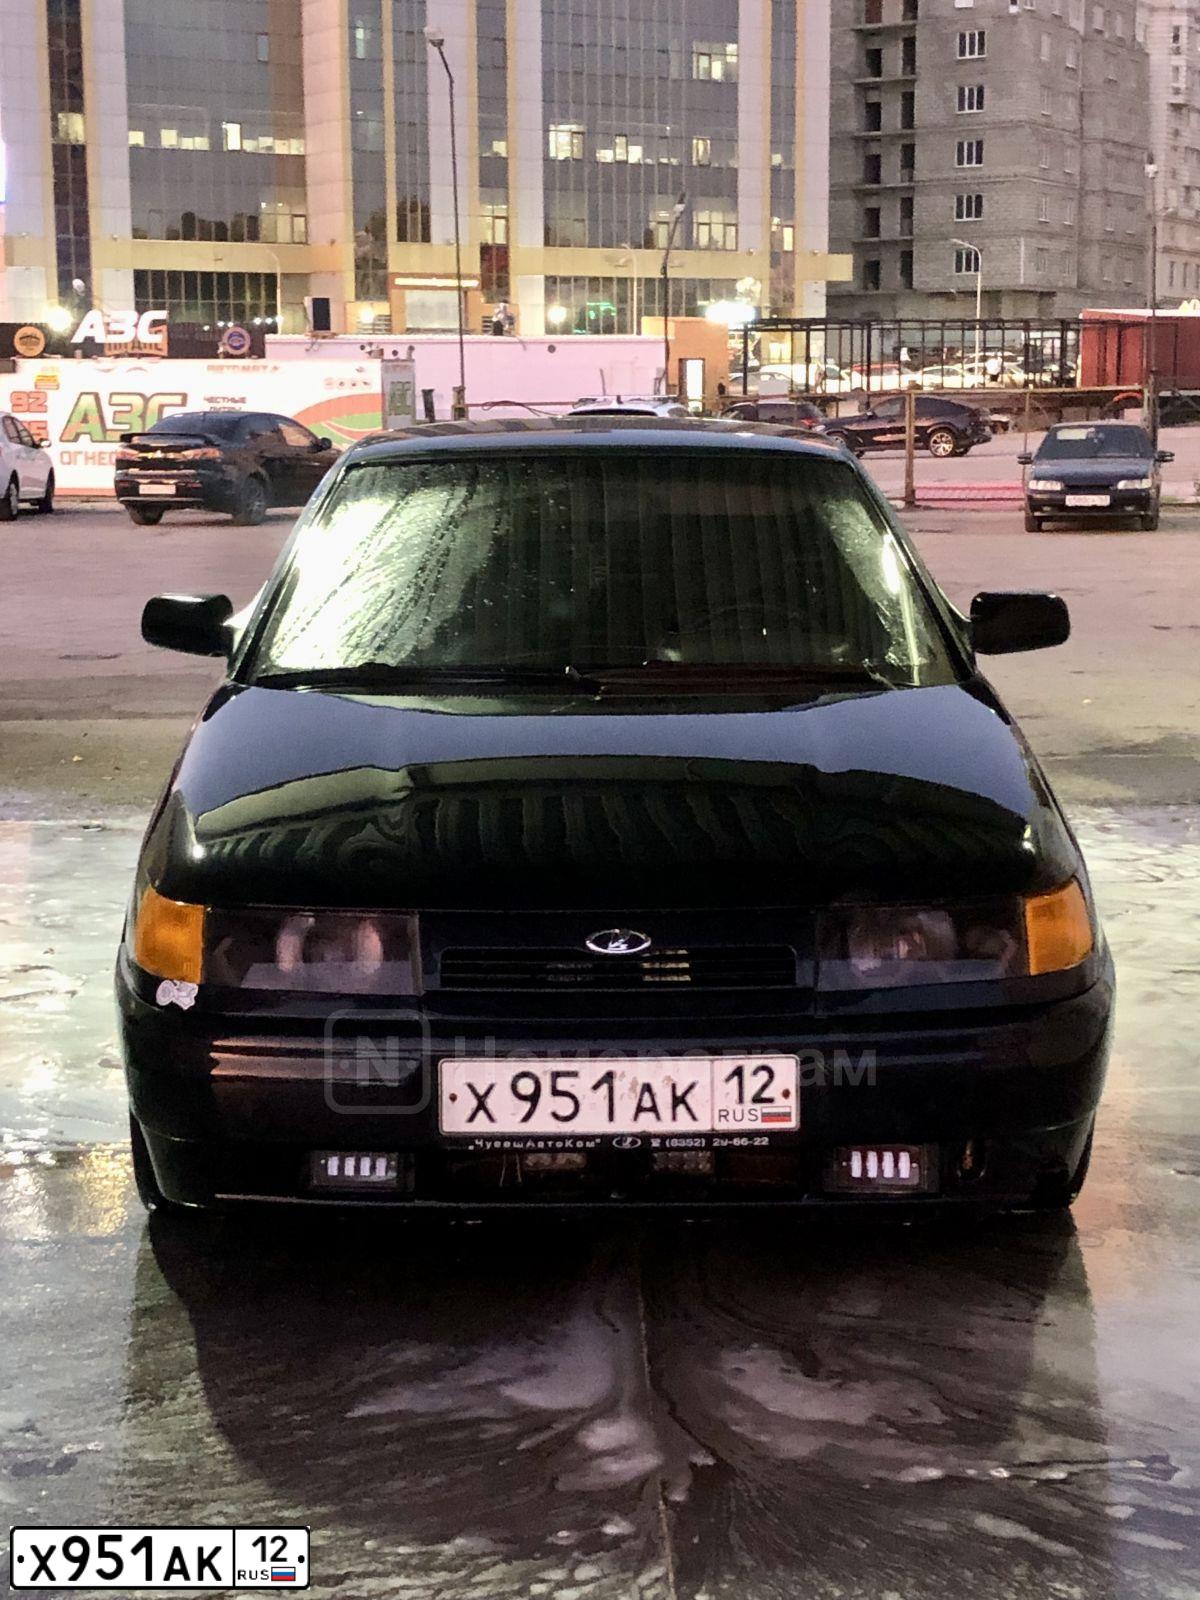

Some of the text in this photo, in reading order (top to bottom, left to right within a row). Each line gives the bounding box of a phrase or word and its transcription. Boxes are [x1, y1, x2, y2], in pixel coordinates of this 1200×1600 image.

[71, 309, 169, 344] АЗС
[10, 391, 48, 413] 92
[724, 1065, 775, 1104] 12
[718, 1108, 759, 1123] RUS
